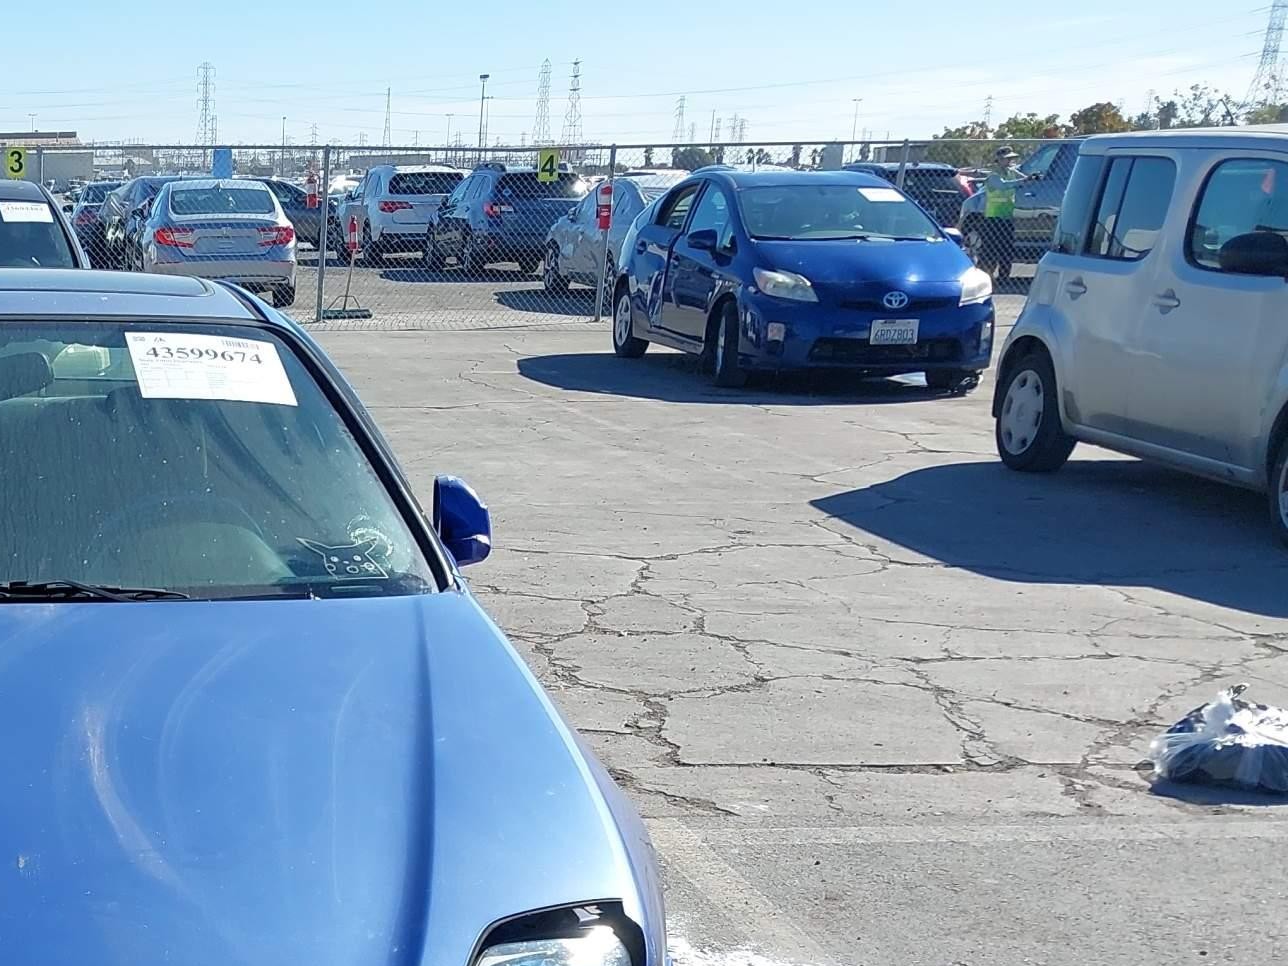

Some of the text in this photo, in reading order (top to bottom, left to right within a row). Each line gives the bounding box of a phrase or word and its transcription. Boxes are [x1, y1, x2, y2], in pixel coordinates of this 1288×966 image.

[10, 151, 23, 172] 3
[541, 155, 556, 177] 4
[145, 346, 263, 365] 43599674
